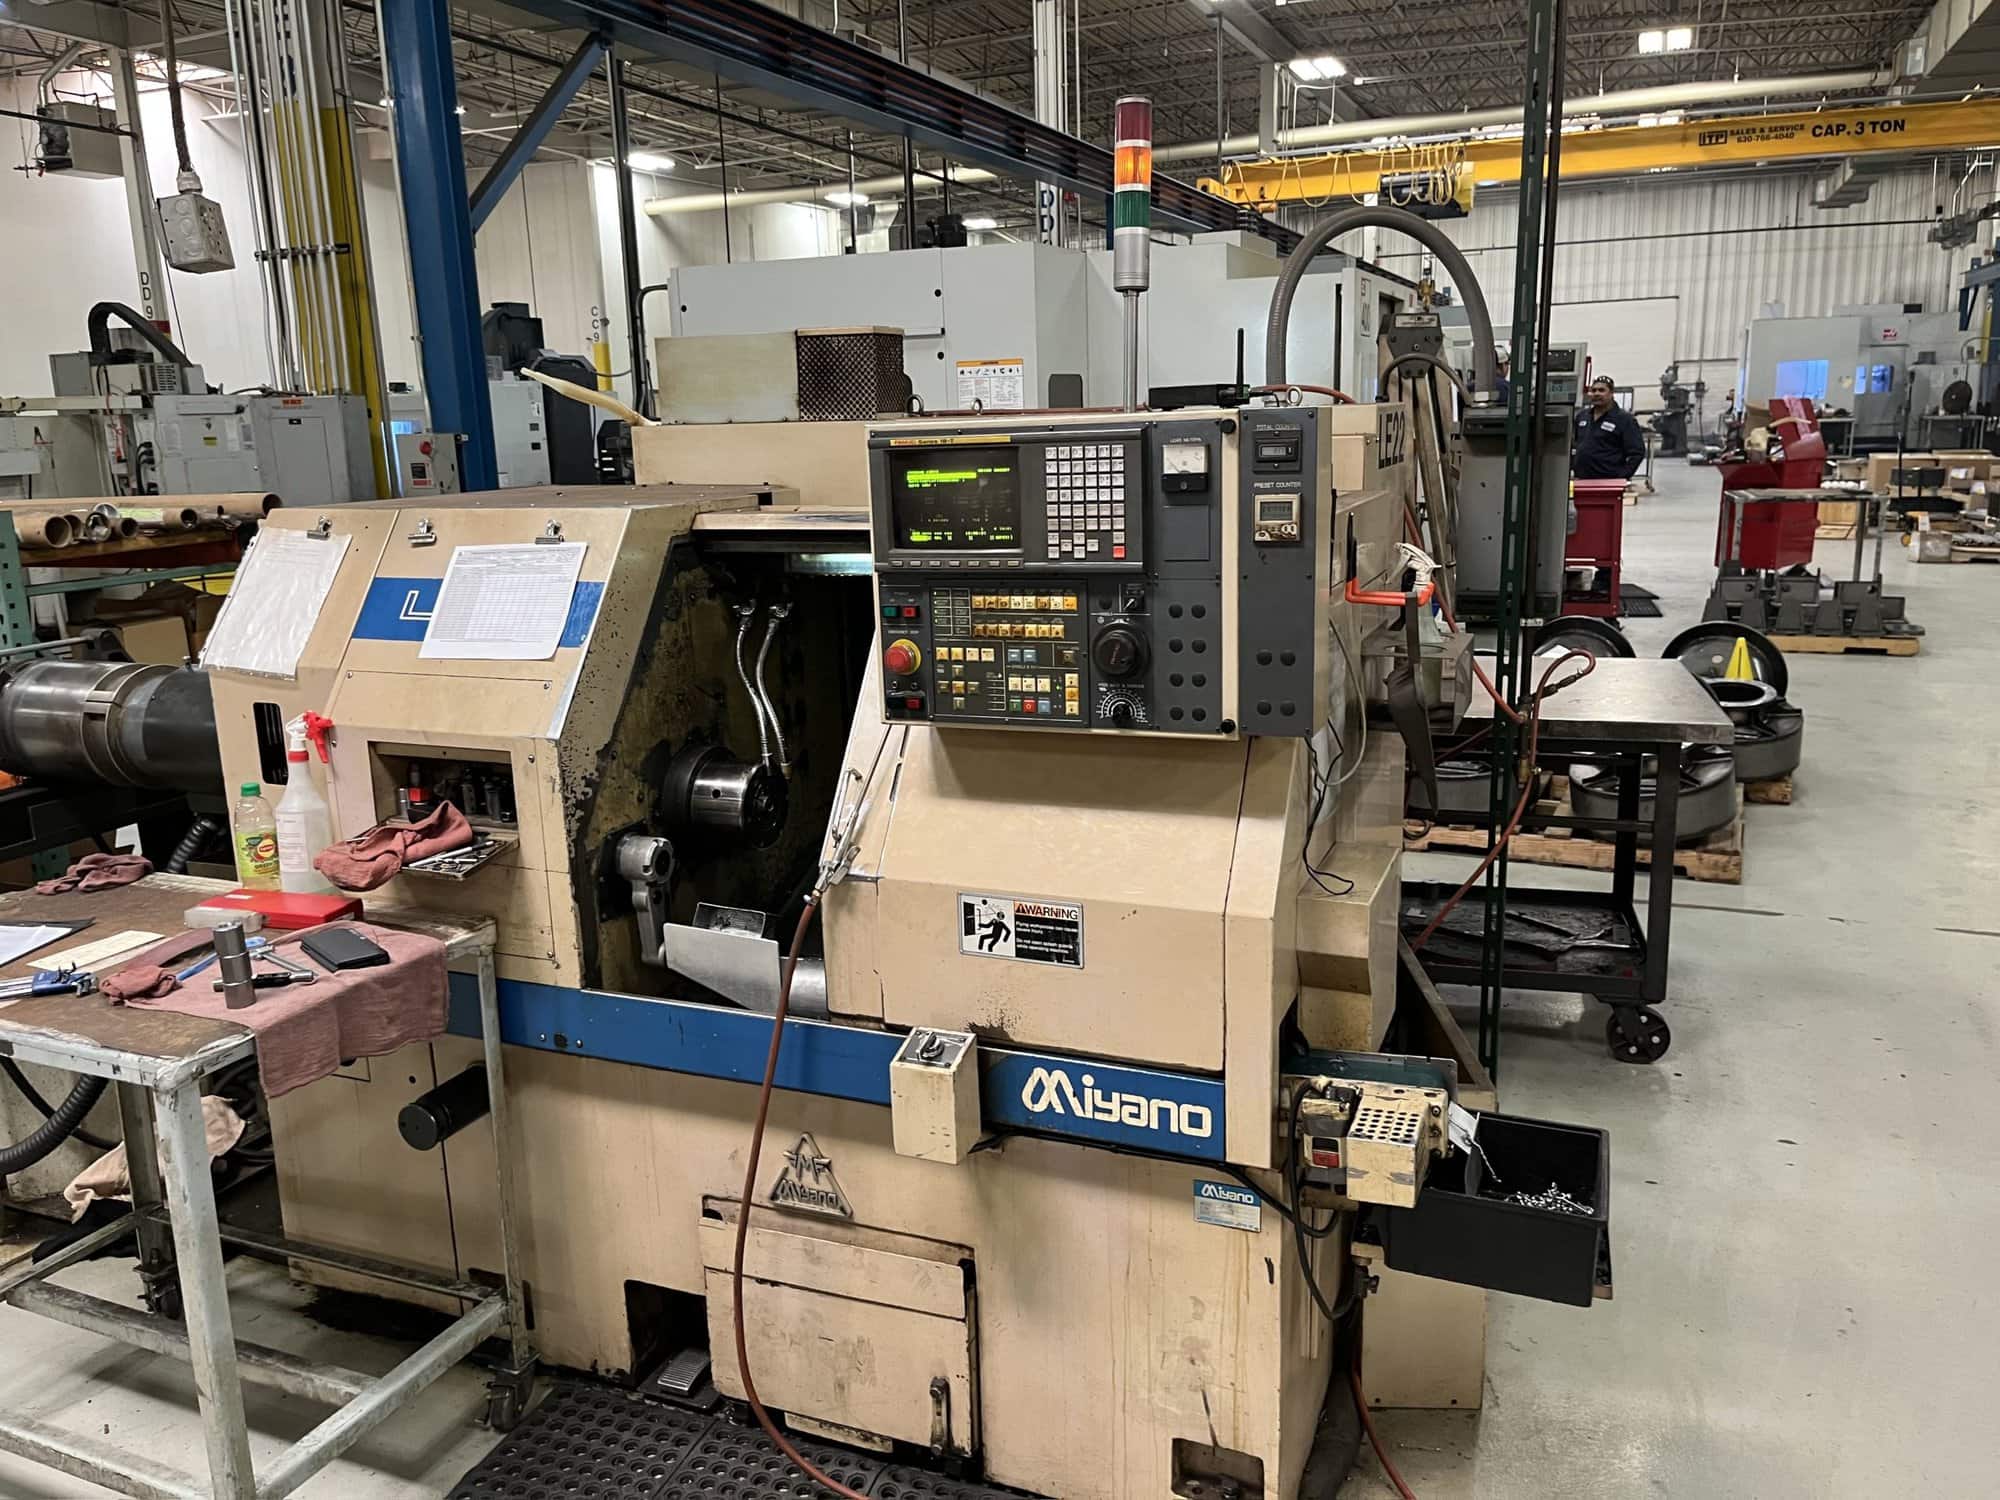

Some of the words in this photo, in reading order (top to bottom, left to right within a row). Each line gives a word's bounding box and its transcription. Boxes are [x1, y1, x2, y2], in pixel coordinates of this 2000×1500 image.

[1729, 127, 1757, 137] SALES
[1768, 123, 1805, 133] SERVICE
[1811, 124, 1851, 138] CAP.
[1855, 121, 1865, 136] 3
[1868, 119, 1905, 134] TON
[1040, 189, 1054, 246] DD
[1378, 410, 1405, 469] LE22
[1024, 905, 1078, 920] WARNING
[1021, 1067, 1212, 1138] Miyano
[1201, 1183, 1254, 1204] Miyano
